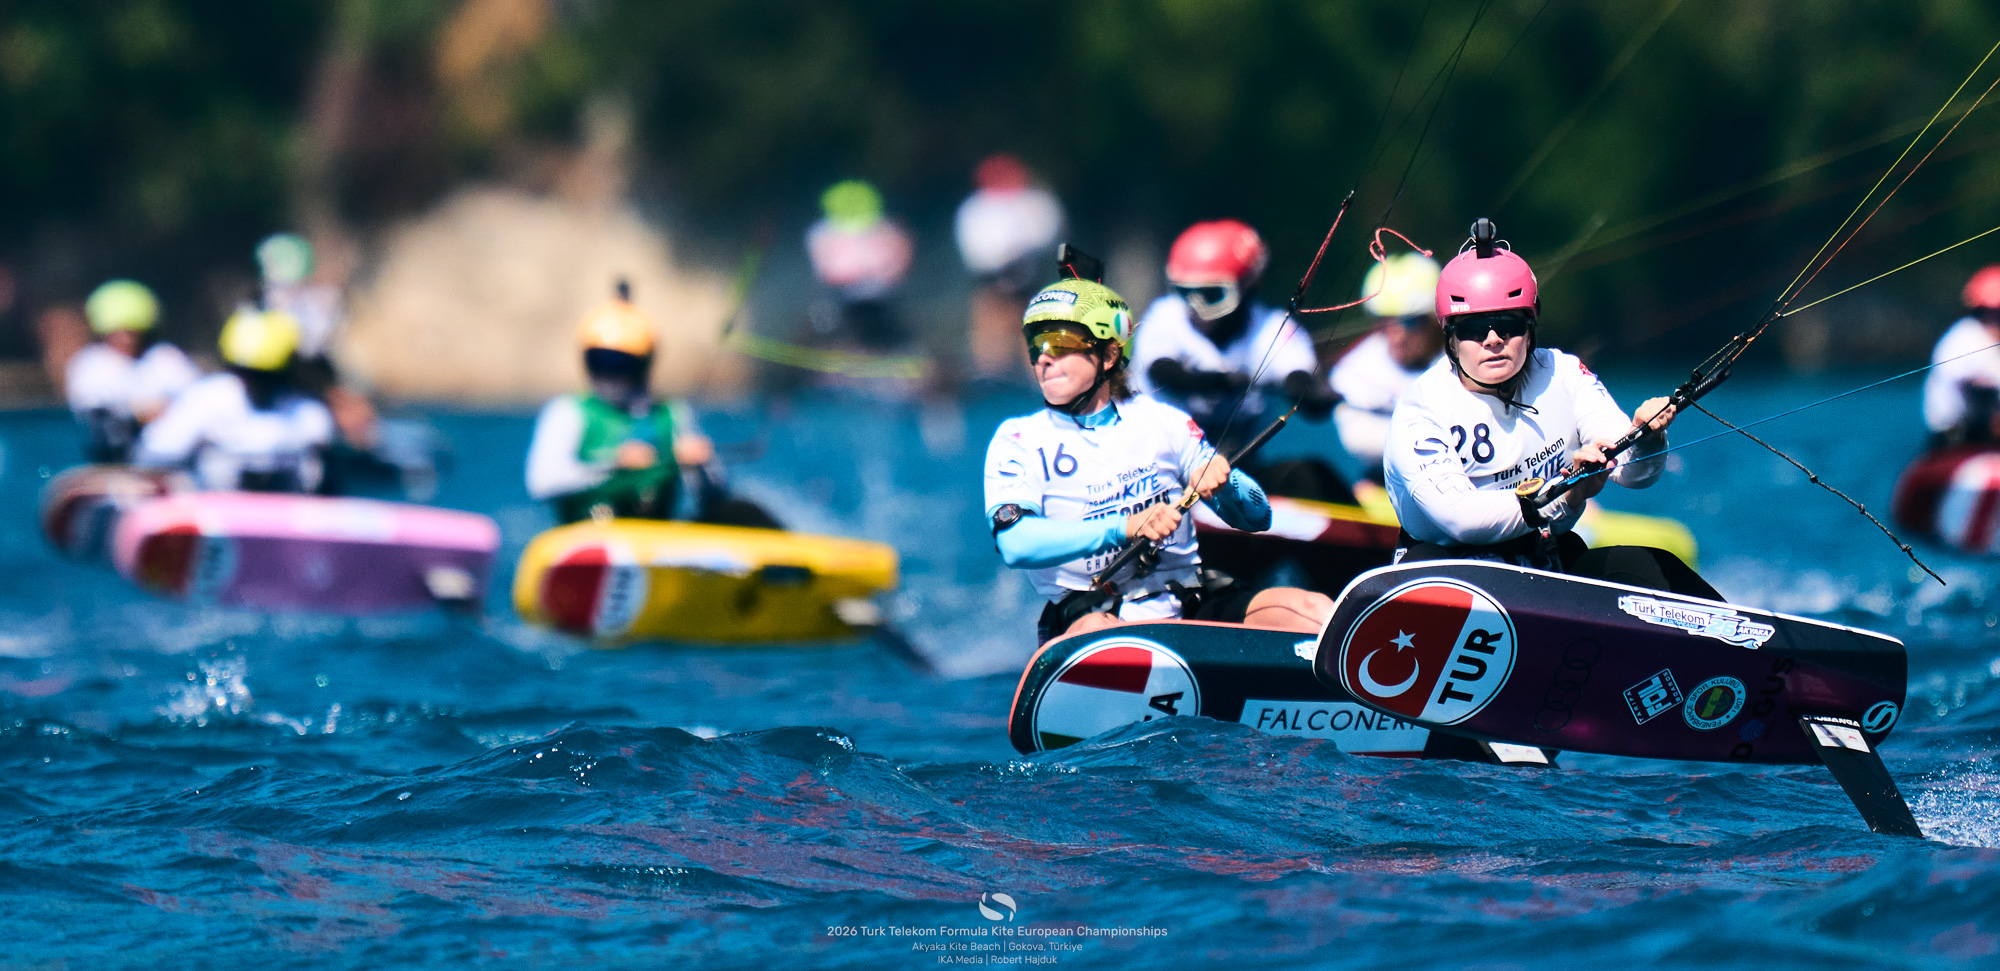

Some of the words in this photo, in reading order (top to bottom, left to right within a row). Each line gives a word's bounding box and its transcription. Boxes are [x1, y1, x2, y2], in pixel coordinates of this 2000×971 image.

[1450, 304, 1471, 313] WIP
[1450, 422, 1495, 464] 28
[1036, 442, 1079, 482] 16
[1493, 465, 1523, 483] Türk
[1525, 437, 1565, 469] Telekom
[1532, 449, 1566, 481] KITE
[1086, 480, 1113, 496] Türk
[1122, 472, 1161, 501] KITE
[1632, 601, 1657, 615] Türk
[1658, 606, 1705, 626] Telekom
[1706, 619, 1738, 637] 26
[1738, 626, 1770, 638] AKYAKA
[1437, 628, 1504, 705] TUR
[1257, 708, 1416, 732] FALCONER
